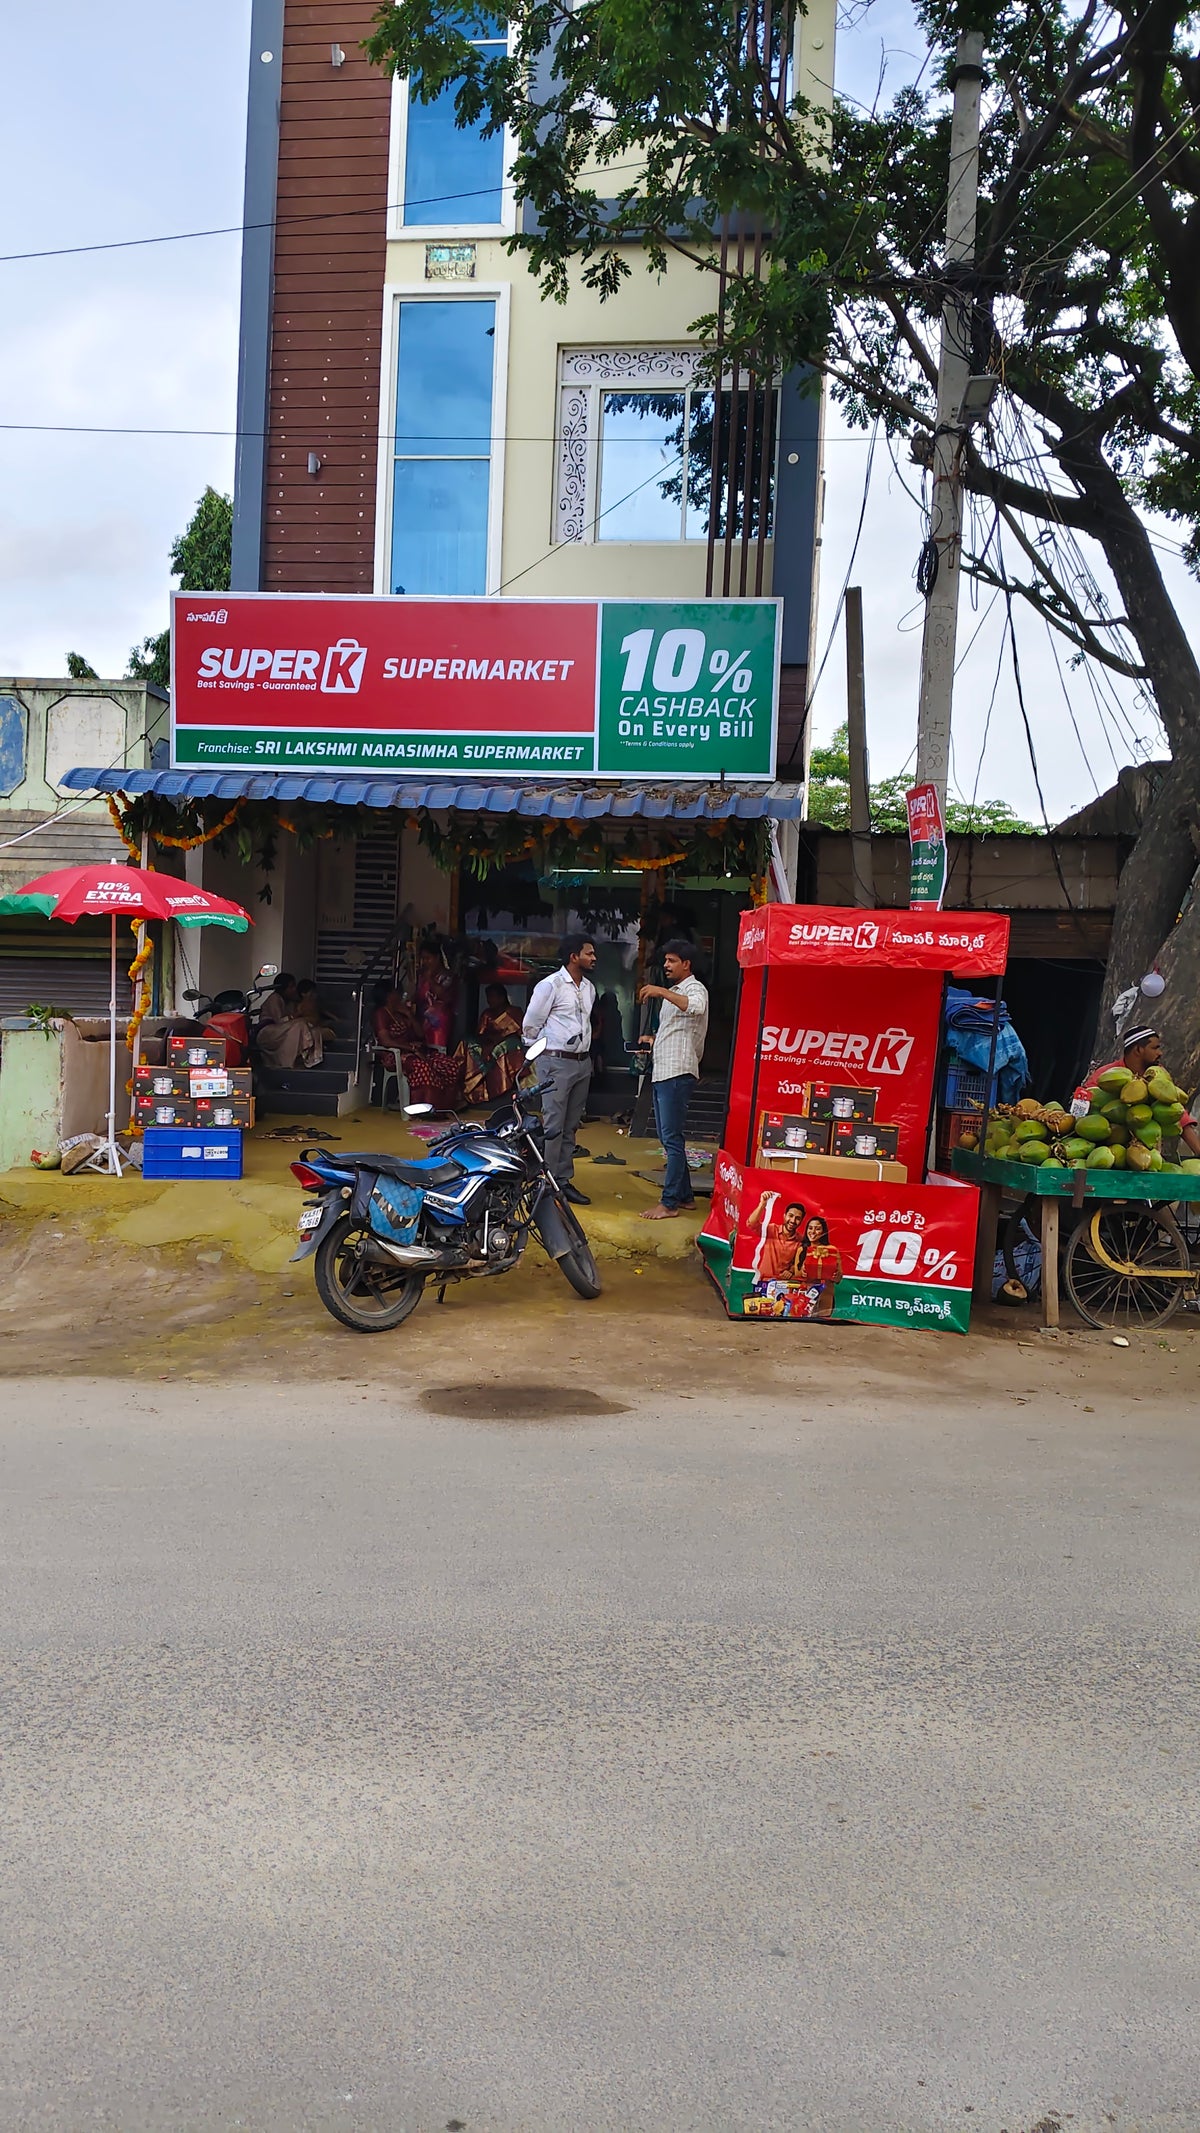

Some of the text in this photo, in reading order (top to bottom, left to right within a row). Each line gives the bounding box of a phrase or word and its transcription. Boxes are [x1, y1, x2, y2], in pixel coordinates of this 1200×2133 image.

[383, 658, 574, 680] SUPERMARKET
[620, 628, 753, 693] 10%
[197, 681, 217, 689] Best
[219, 681, 254, 691] Savings
[262, 682, 316, 690] Guaranteed
[619, 697, 757, 718] CASHBACK
[618, 720, 753, 741] On Every Bill
[197, 741, 584, 760] Franchise: SRI LAKSHMI NARASIMHA SUPERMARKET
[97, 881, 130, 891] 10%
[86, 891, 142, 902] EXTRA
[892, 931, 986, 952] సూపర్ మార్కెట్
[774, 1054, 806, 1064] Savings
[813, 1058, 864, 1070] Guaranteed
[863, 1210, 886, 1225] ప్రతి
[855, 1229, 957, 1281] 10%
[852, 1295, 892, 1309] EXTRA
